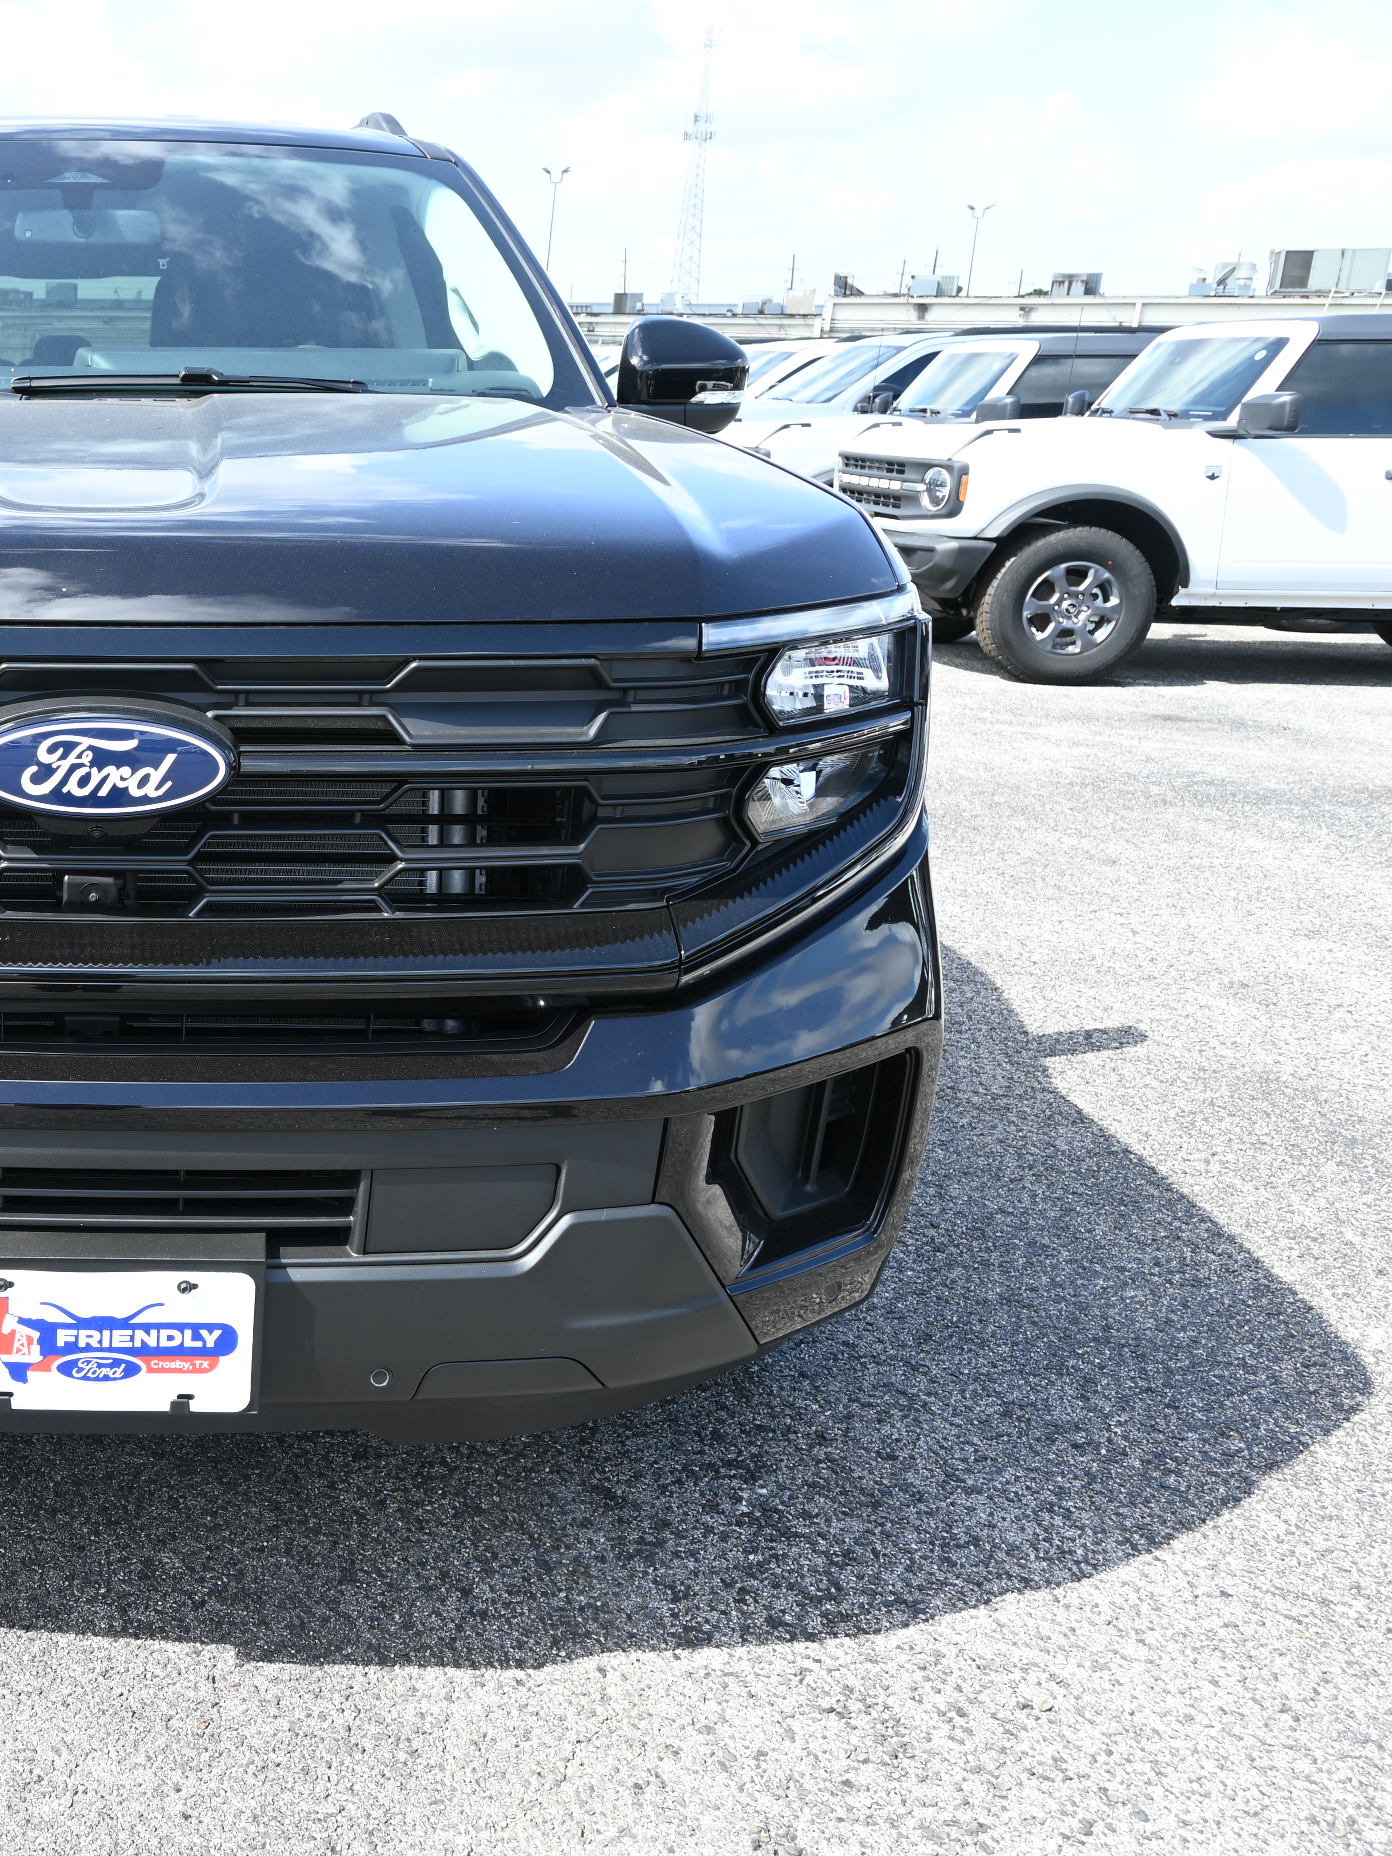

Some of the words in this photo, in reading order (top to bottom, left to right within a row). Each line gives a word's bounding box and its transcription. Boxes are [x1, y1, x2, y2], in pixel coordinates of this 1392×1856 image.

[20, 734, 177, 798] Ford
[55, 1327, 223, 1349] FRIENDLY
[71, 1358, 125, 1379] Ford
[150, 1359, 193, 1371] Crosby,
[194, 1359, 210, 1370] TX
